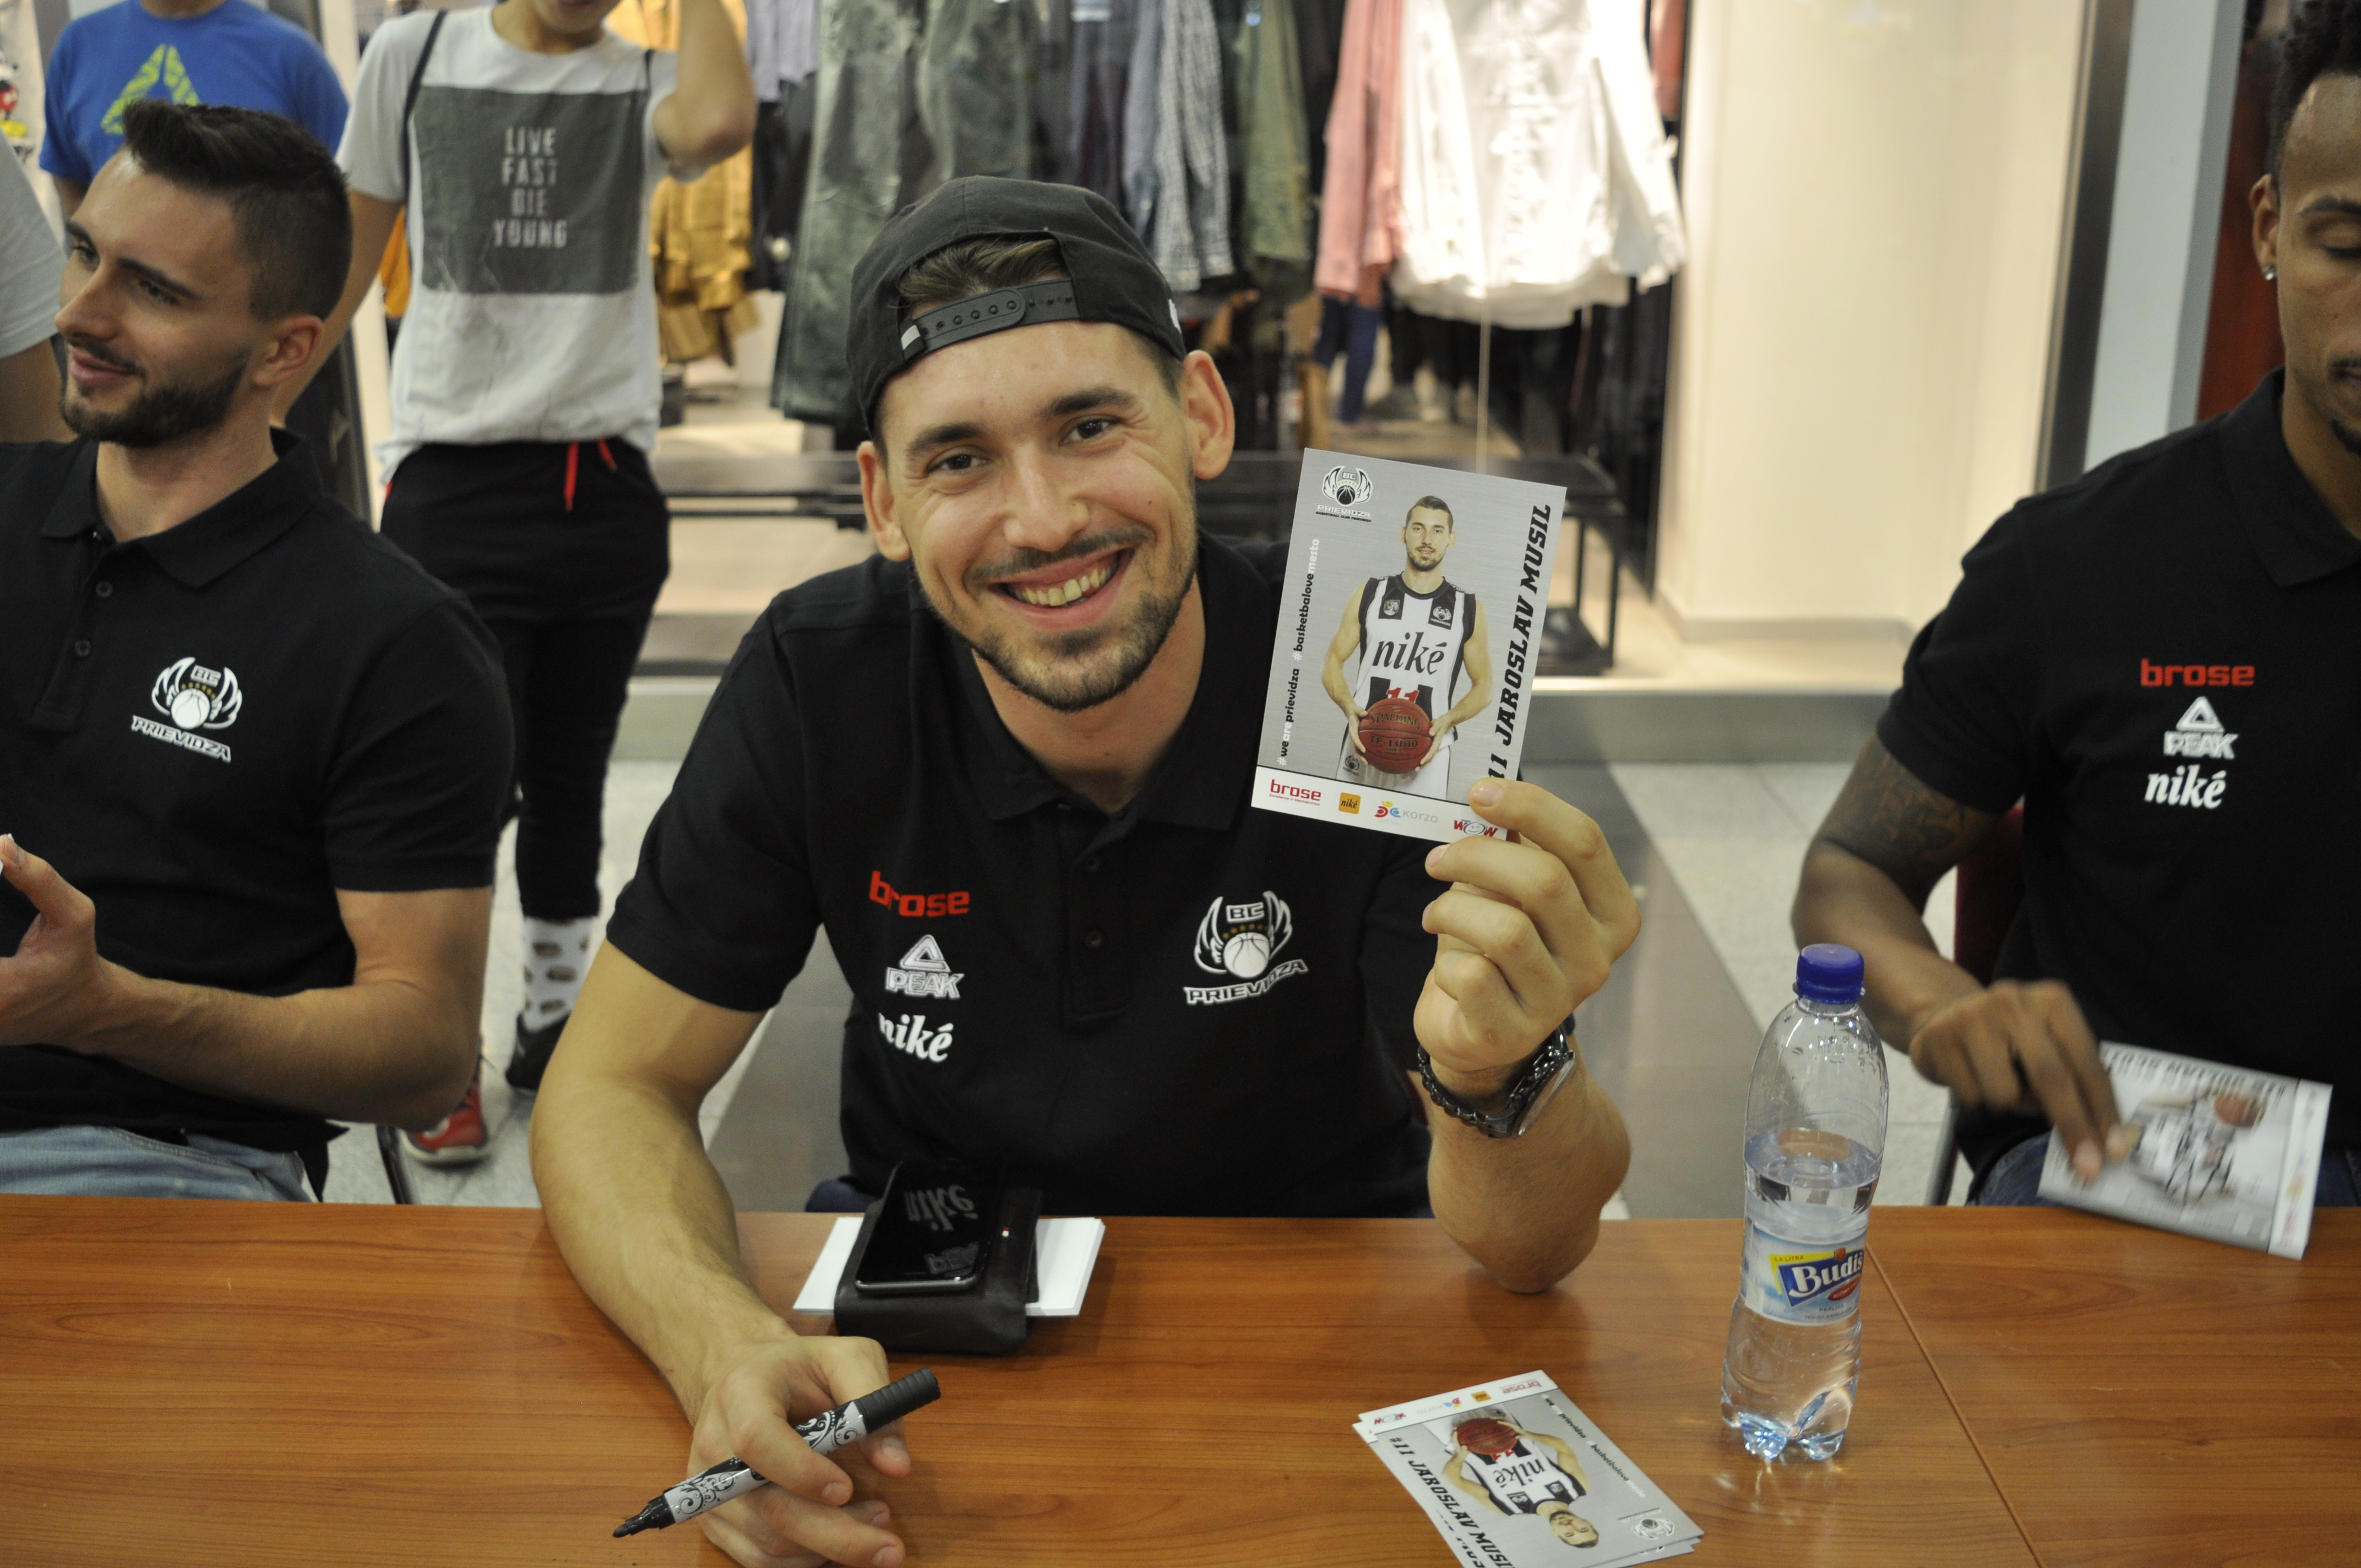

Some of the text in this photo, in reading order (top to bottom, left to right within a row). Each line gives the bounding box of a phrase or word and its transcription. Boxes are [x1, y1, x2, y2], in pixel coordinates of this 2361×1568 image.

[504, 127, 557, 156] LIVE
[500, 157, 559, 187] FAST
[510, 188, 548, 218] DIE
[493, 219, 568, 249] YOUNG
[1342, 472, 1357, 481] BC
[1317, 504, 1371, 518] PRIEVIDZA
[1495, 594, 1533, 747] JAROSLAV
[1520, 504, 1551, 595] MUSIL
[1372, 631, 1448, 675] niké
[2140, 658, 2255, 687] brose
[1369, 714, 1421, 731] SPALDING
[131, 715, 231, 764] PRIEVIDZA
[2163, 730, 2239, 760] PEAK
[1270, 779, 1321, 801] brose
[2145, 764, 2227, 809] niké
[1341, 799, 1358, 809] niké
[869, 870, 970, 918] brose
[1226, 901, 1265, 923] BC
[885, 967, 965, 1000] PEAK
[1183, 959, 1309, 1005] PRIEVIDZA
[878, 1012, 954, 1063] niké
[1493, 1459, 1546, 1488] niké
[1407, 1460, 1479, 1528] JAROSLAV
[1468, 1531, 1517, 1568] MUSI
